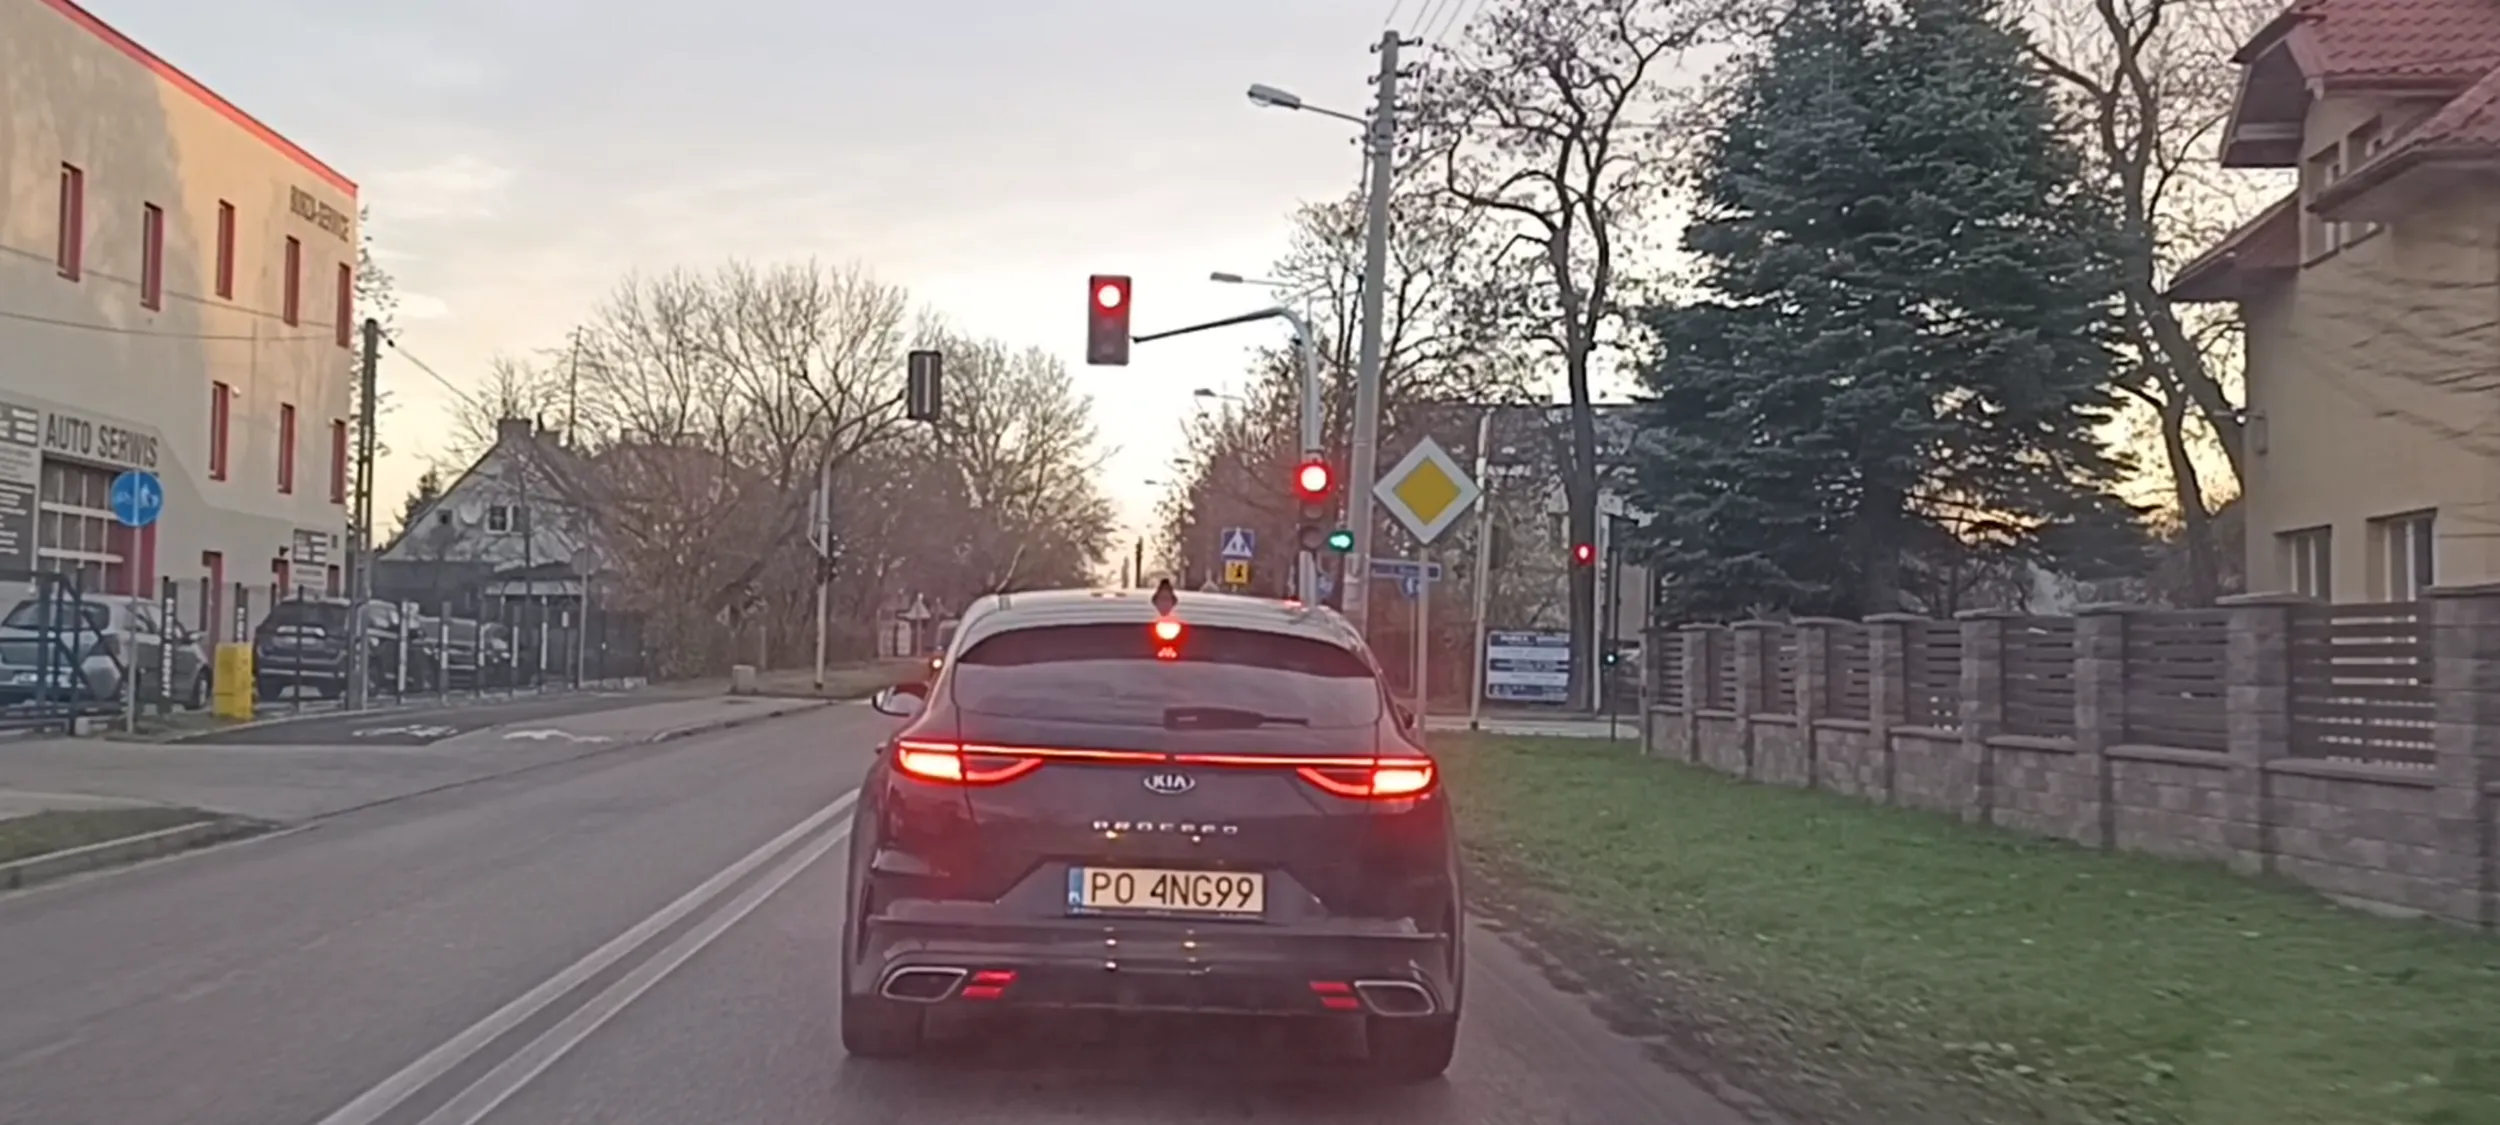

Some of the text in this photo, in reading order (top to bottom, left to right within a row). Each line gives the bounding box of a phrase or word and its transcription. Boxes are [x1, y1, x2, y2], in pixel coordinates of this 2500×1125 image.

[45, 413, 92, 455] AUTO
[97, 424, 158, 468] SERWIS
[1151, 774, 1187, 789] KIA
[1091, 871, 1254, 909] PO 4NG99
